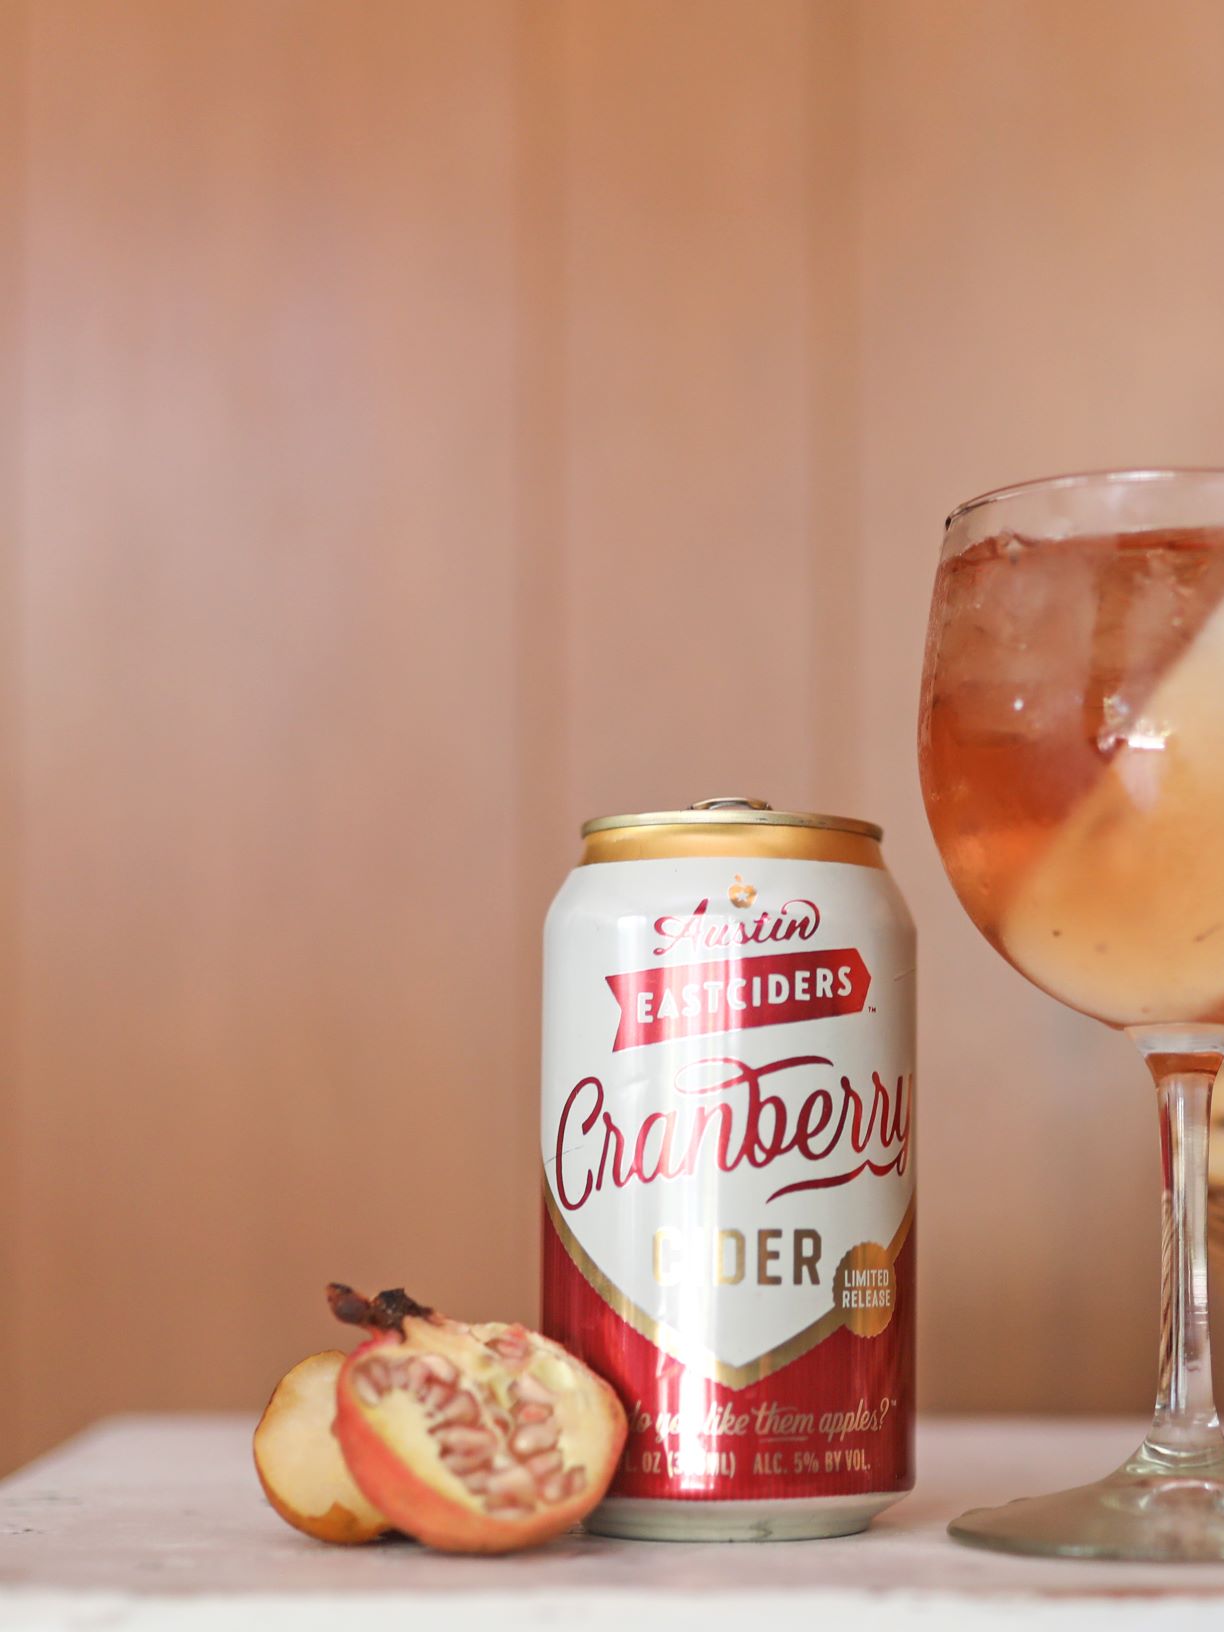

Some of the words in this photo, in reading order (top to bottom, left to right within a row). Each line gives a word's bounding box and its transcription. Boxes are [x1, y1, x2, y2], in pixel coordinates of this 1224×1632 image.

[653, 898, 820, 955] Austin
[637, 965, 852, 1024] EASTCIDERS
[555, 1055, 912, 1211] Cranberry
[652, 1228, 822, 1286] CDER
[844, 1268, 889, 1288] LIMITED
[842, 1289, 891, 1309] RELEASE
[656, 1412, 702, 1444] yo
[703, 1401, 750, 1436] like
[751, 1401, 815, 1435] them
[642, 1450, 662, 1474] OZ
[667, 1451, 736, 1479] (3ML)
[753, 1452, 788, 1475] ALC.
[794, 1451, 820, 1474] 5%
[825, 1450, 842, 1473] BY
[844, 1448, 871, 1472] VOL.
